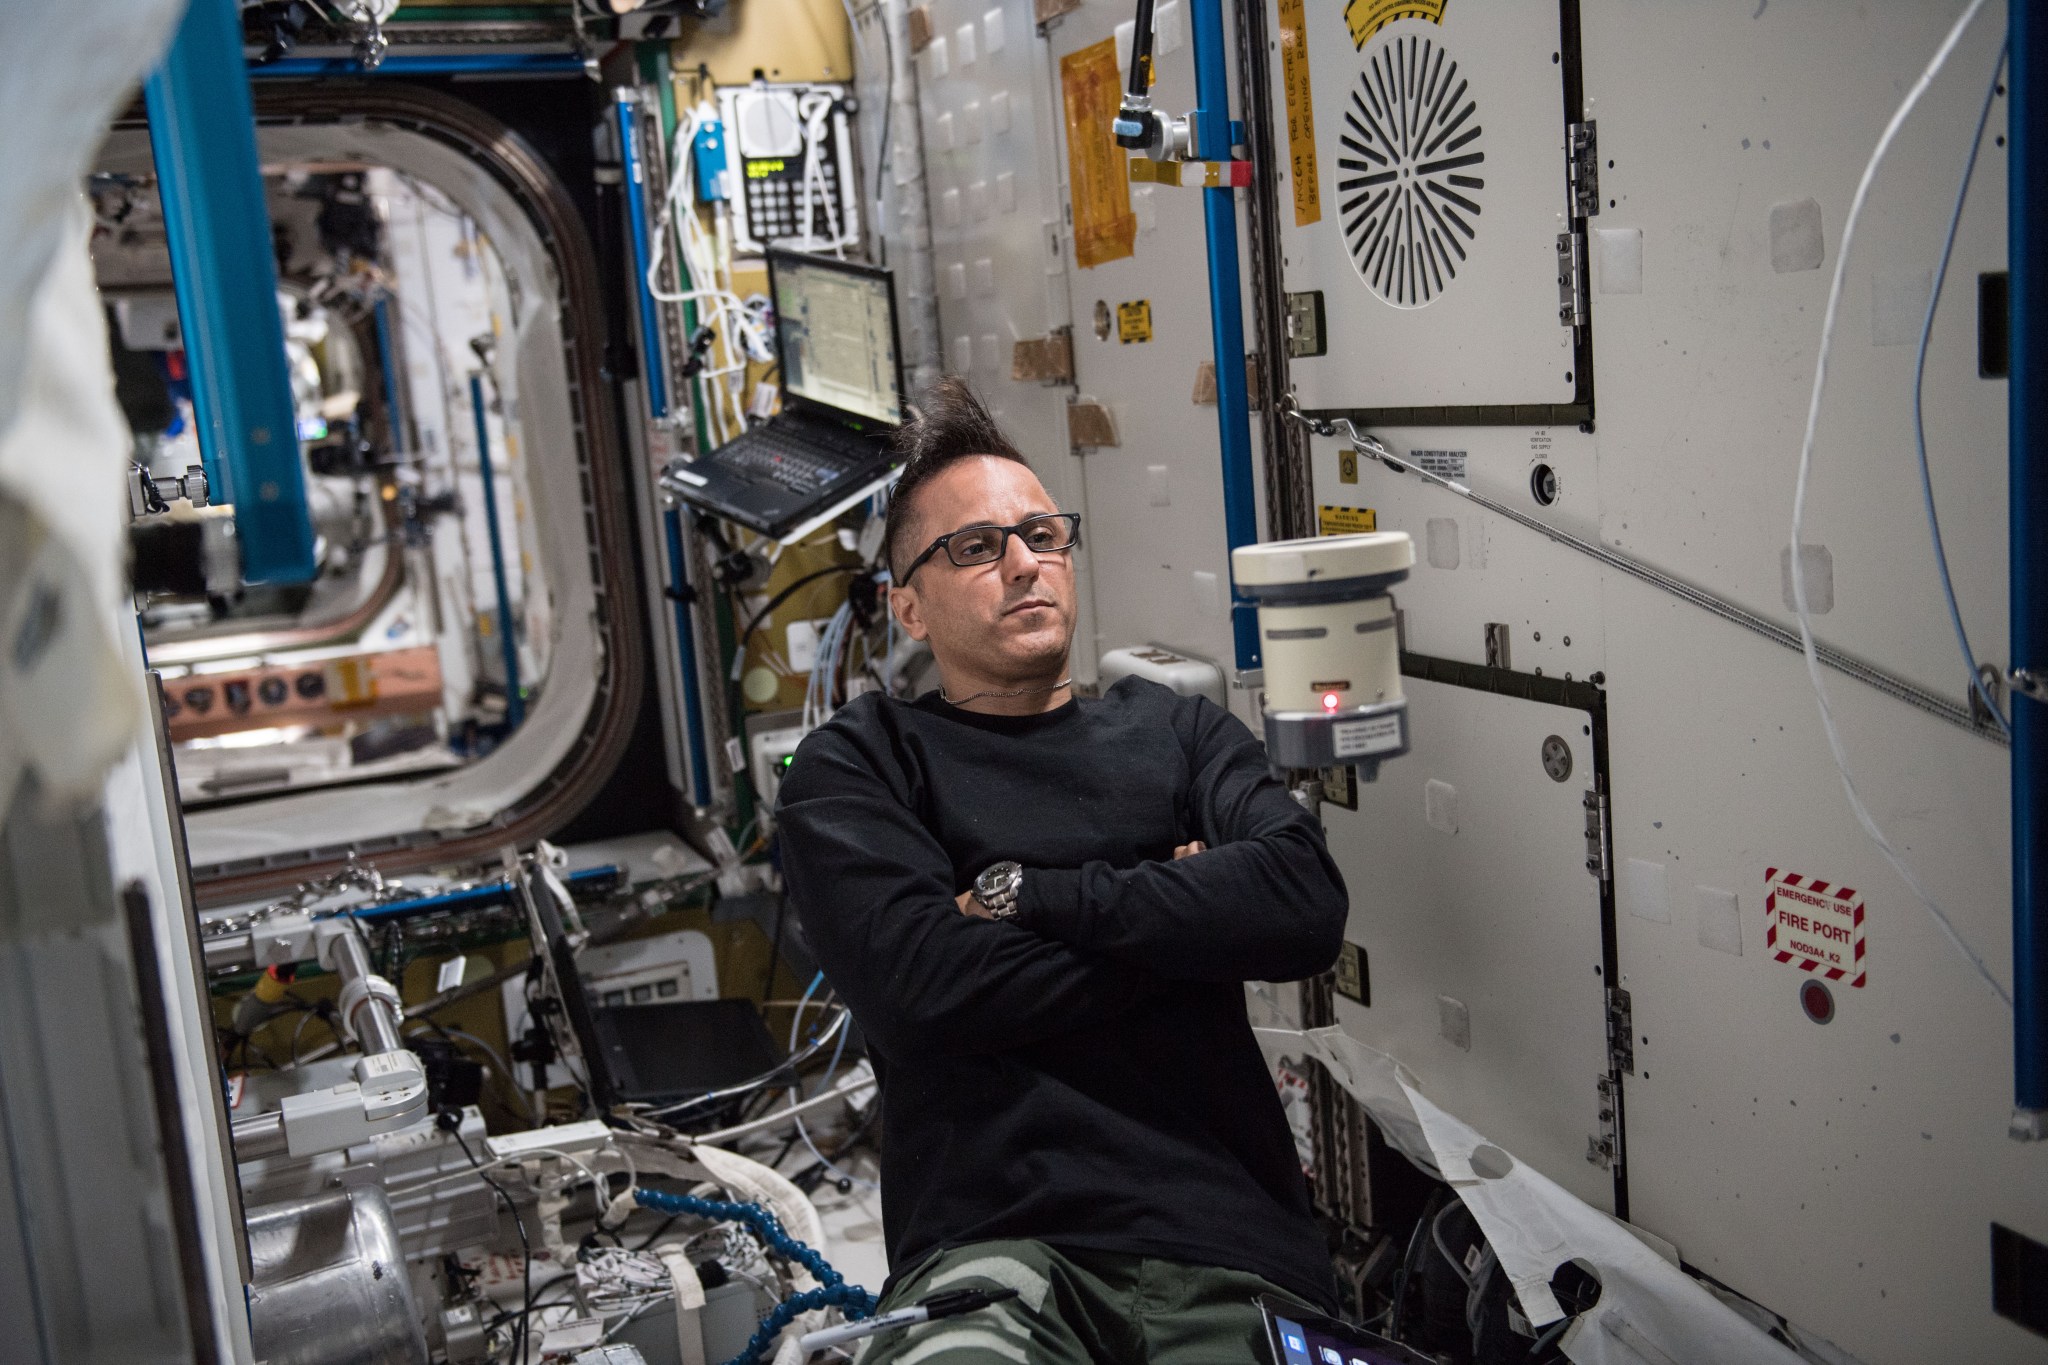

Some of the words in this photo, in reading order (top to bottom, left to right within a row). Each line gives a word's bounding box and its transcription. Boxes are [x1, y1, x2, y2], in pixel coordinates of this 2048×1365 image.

[1296, 24, 1305, 60] RACK
[1300, 76, 1312, 140] OPENING
[1307, 153, 1317, 205] BEFORE
[1776, 886, 1831, 910] EMERGENCY
[1833, 903, 1852, 917] USE
[1779, 910, 1809, 932] FIRE
[1813, 920, 1851, 944] PORT
